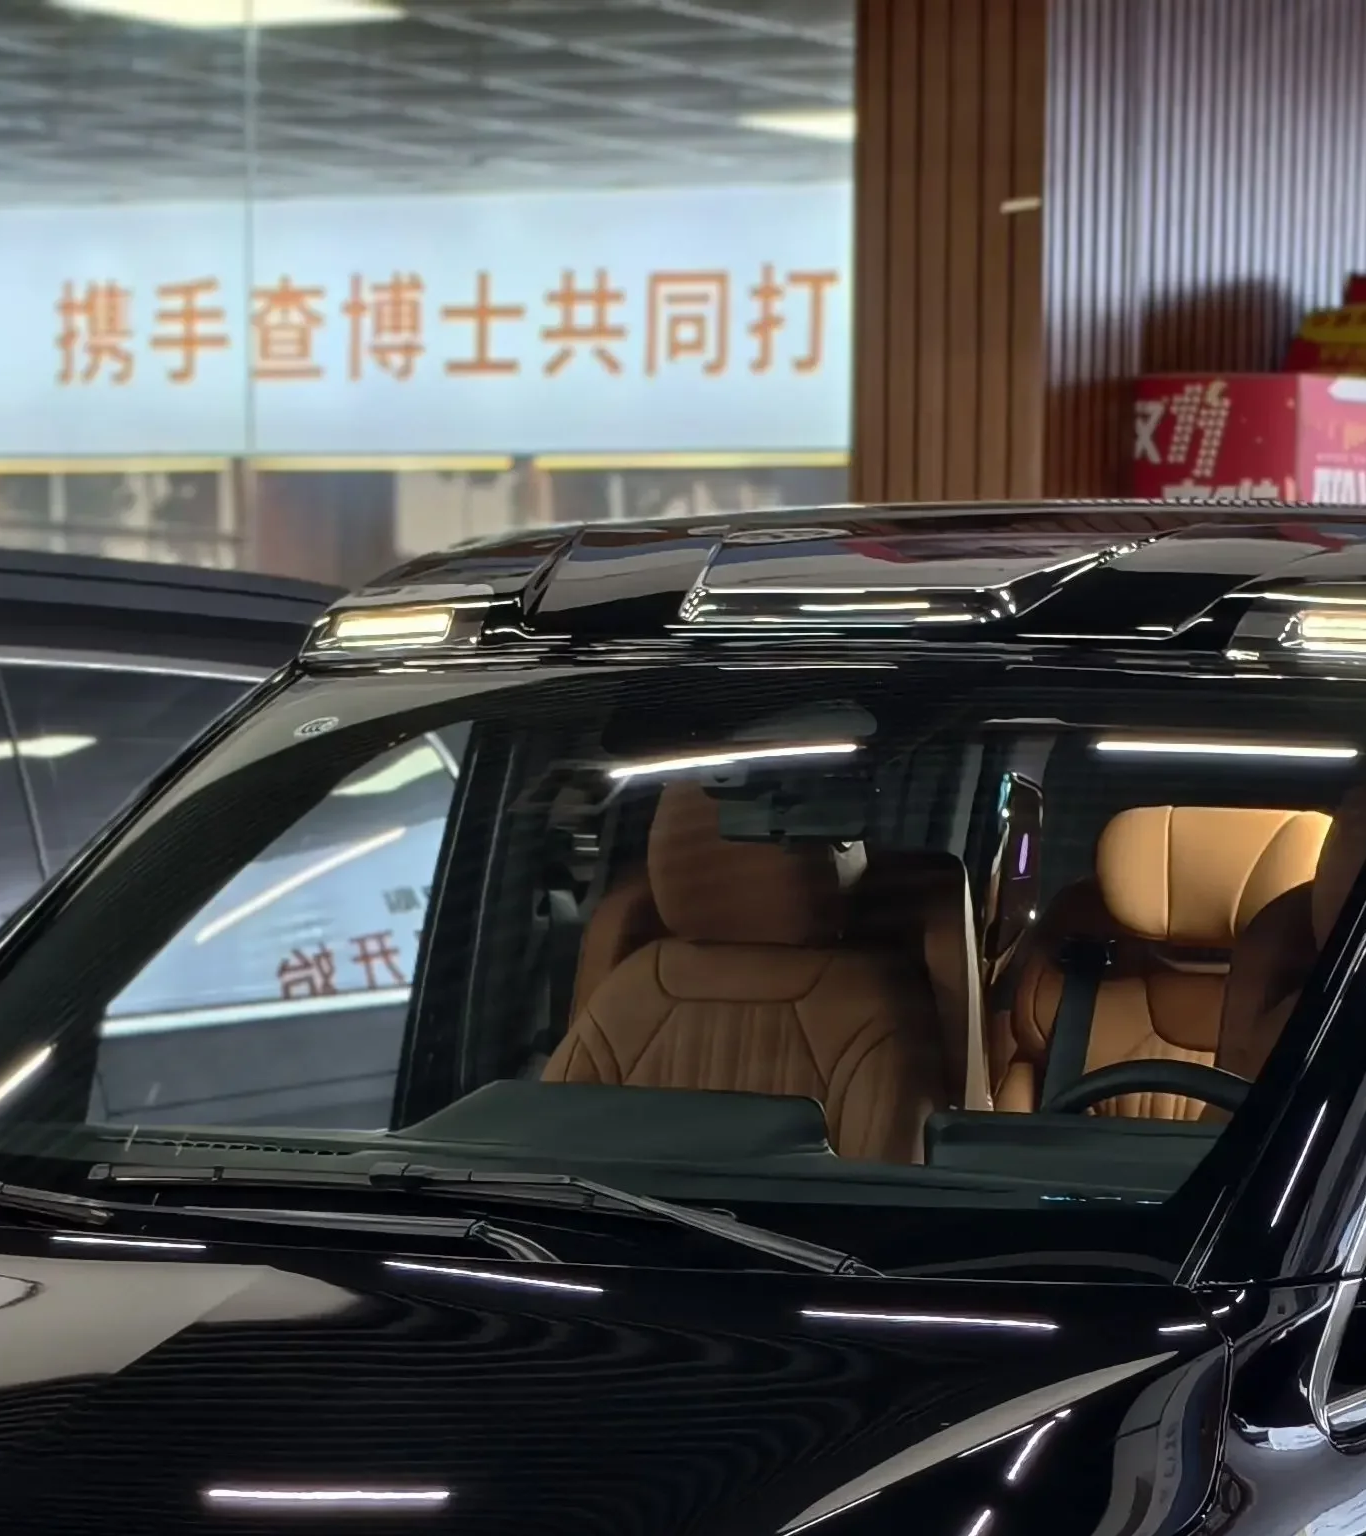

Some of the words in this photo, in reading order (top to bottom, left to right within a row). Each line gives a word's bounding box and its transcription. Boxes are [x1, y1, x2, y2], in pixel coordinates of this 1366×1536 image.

[54, 263, 840, 386] 携手查博士共同打
